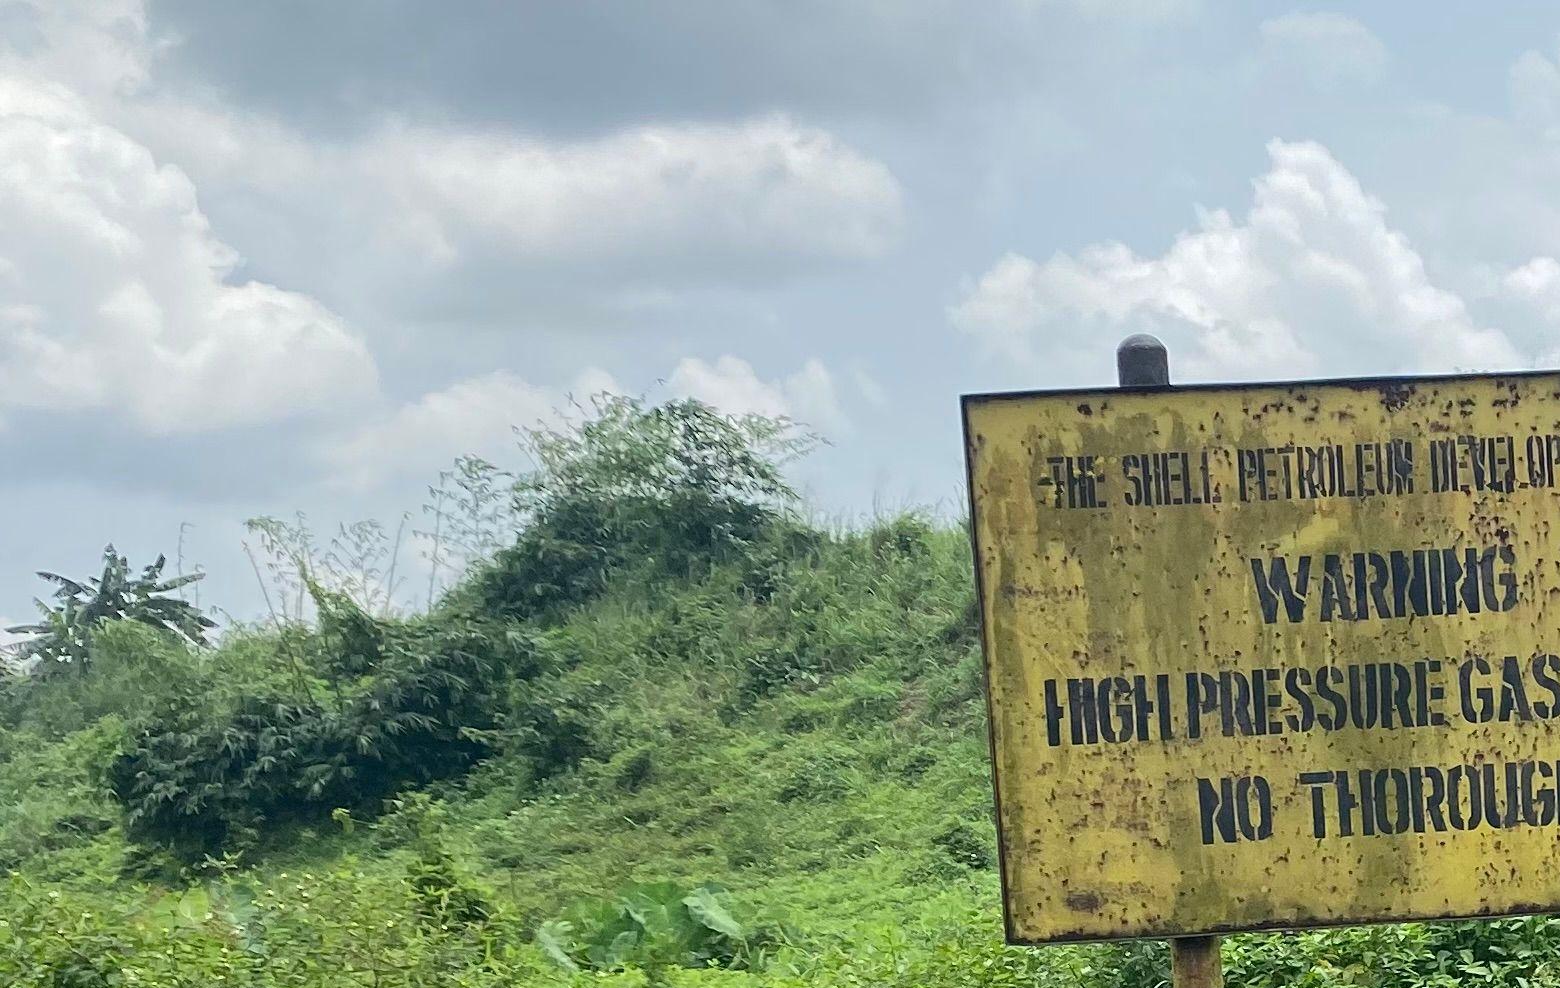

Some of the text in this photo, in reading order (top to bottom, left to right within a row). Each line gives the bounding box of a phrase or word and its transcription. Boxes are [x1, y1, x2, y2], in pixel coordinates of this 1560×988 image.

[1122, 448, 1221, 506] SHELL
[1238, 439, 1414, 502] PETROLEUM
[1251, 545, 1519, 624] WARNING
[1044, 674, 1172, 747] HIGH
[1185, 660, 1446, 739] PRESSURE
[1198, 775, 1273, 844] NO
